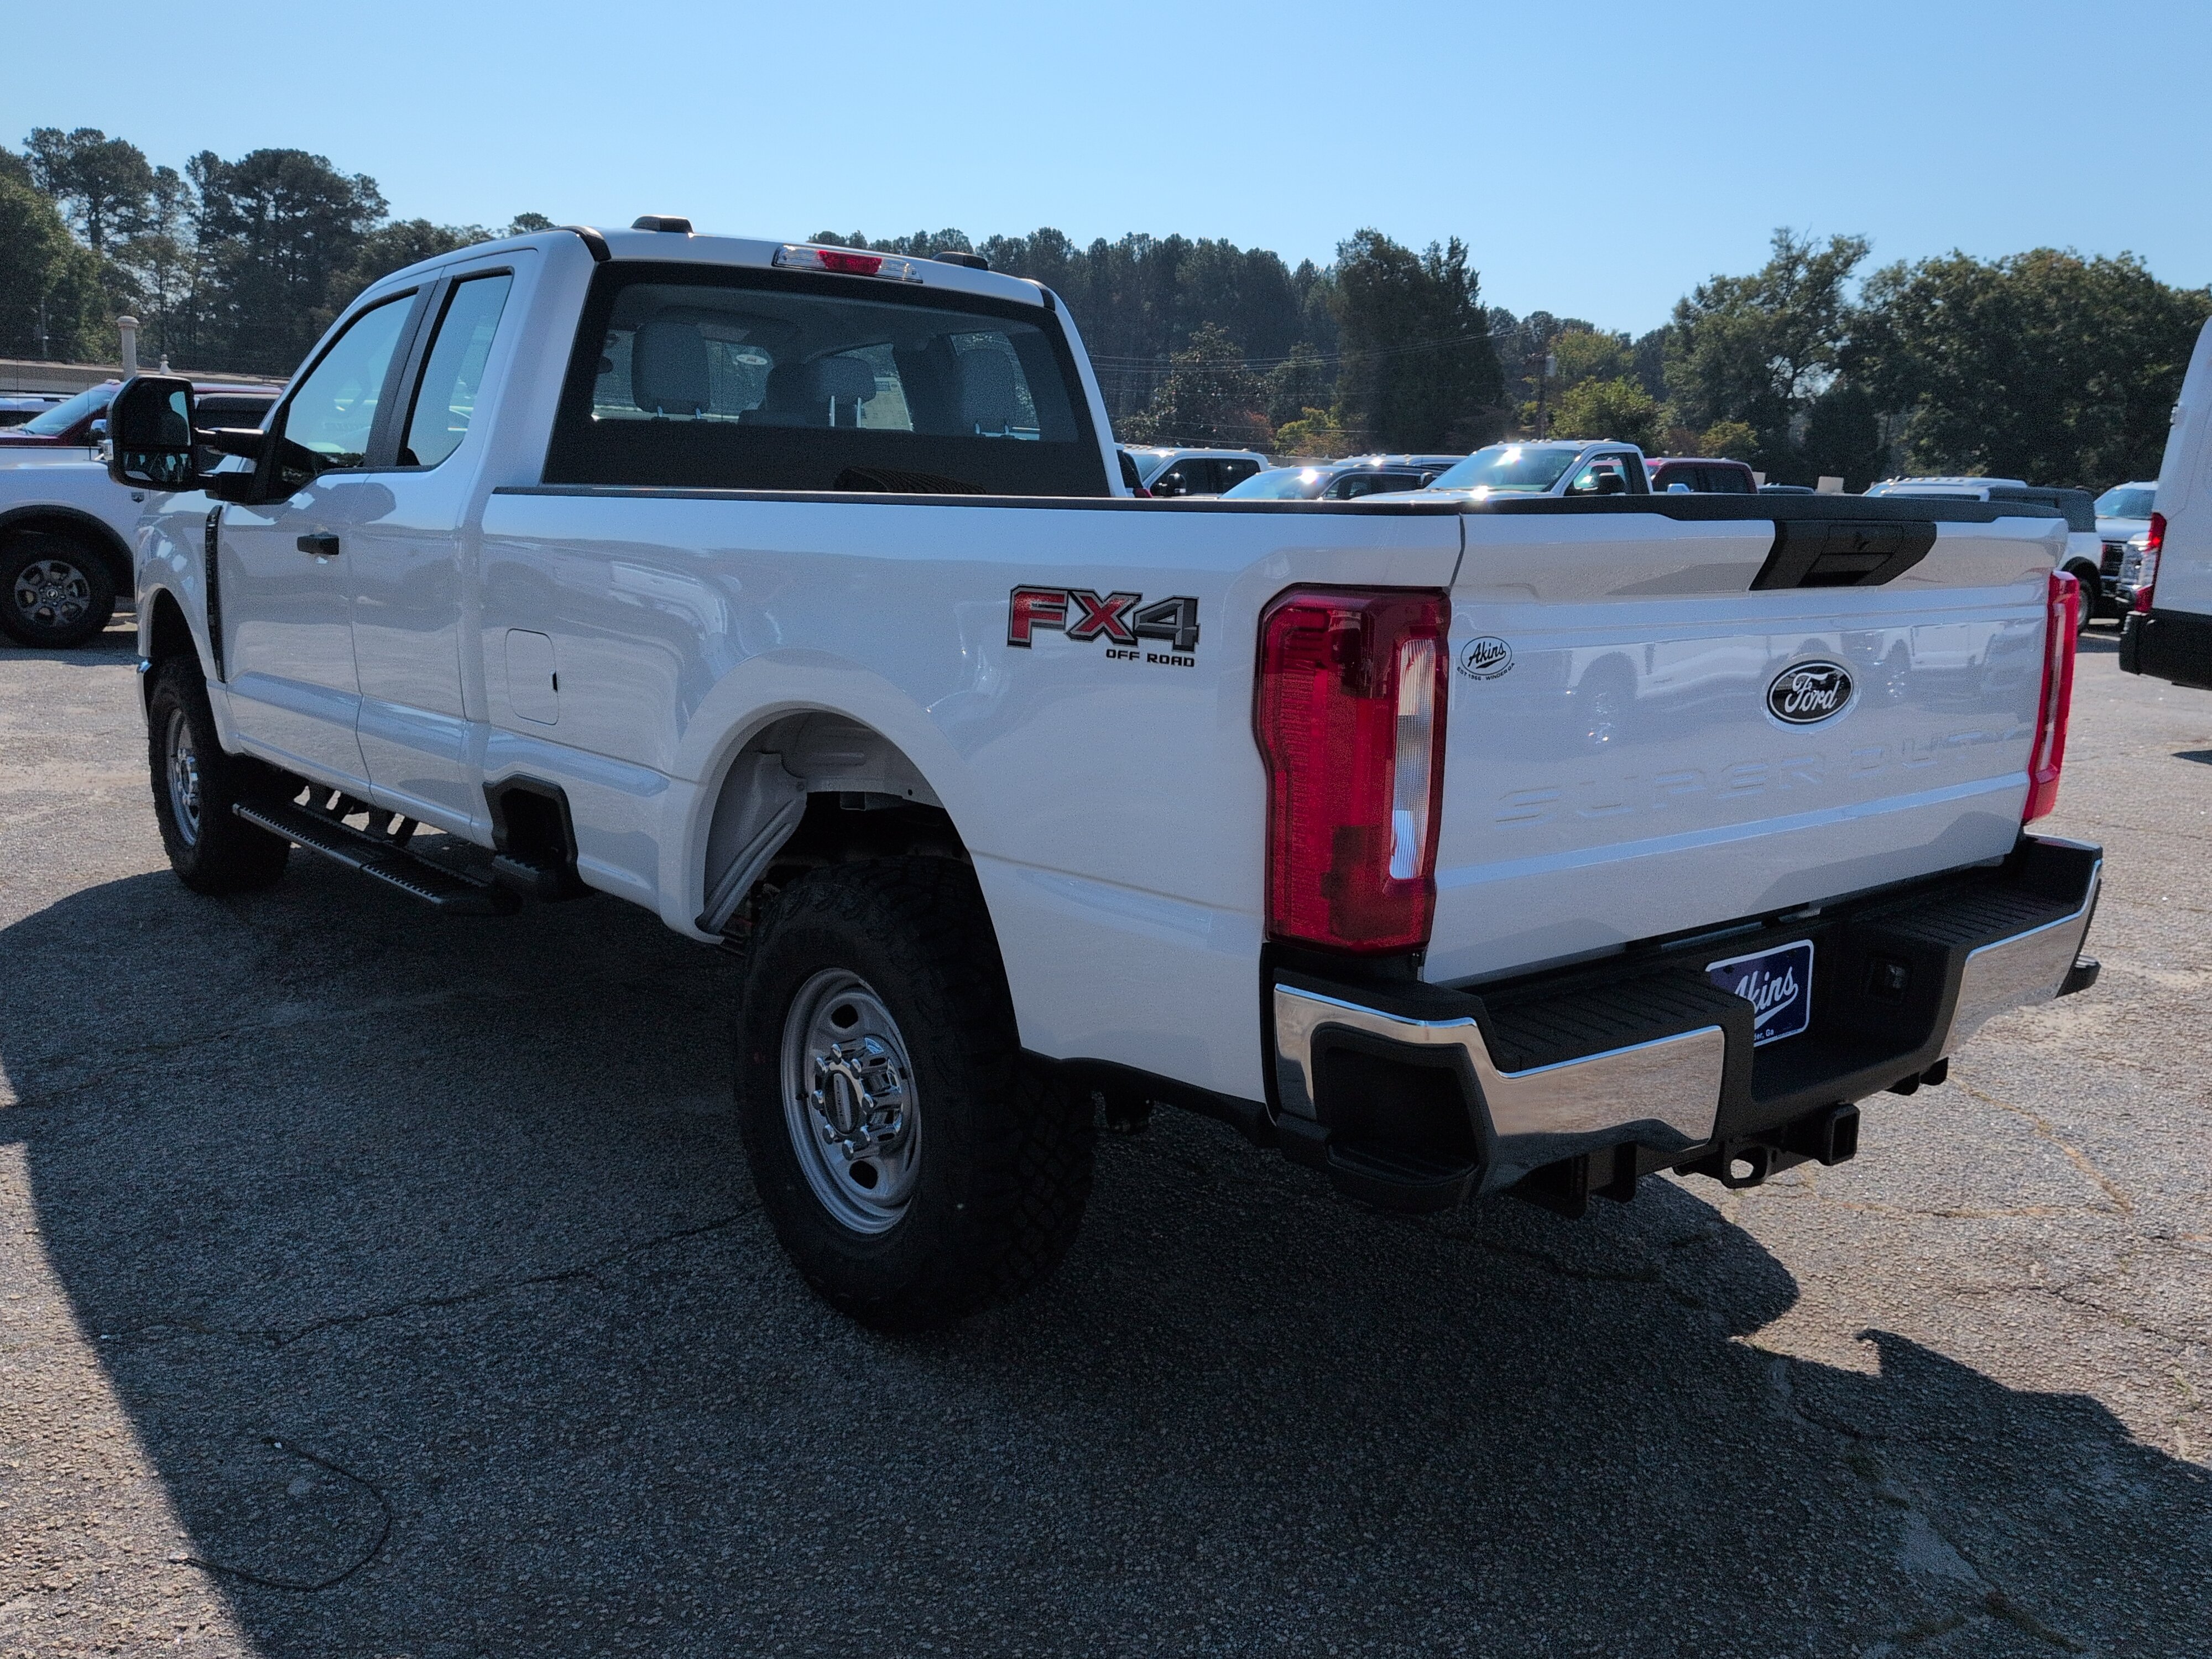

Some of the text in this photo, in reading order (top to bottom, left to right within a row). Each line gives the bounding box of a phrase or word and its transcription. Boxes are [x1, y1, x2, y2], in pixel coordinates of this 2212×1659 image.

[1007, 583, 1199, 653] FX4
[1106, 649, 1195, 667] OFF ROAD
[1468, 641, 1506, 667] Akins
[1486, 670, 1507, 681] WINDER
[1785, 672, 1840, 713] Ford
